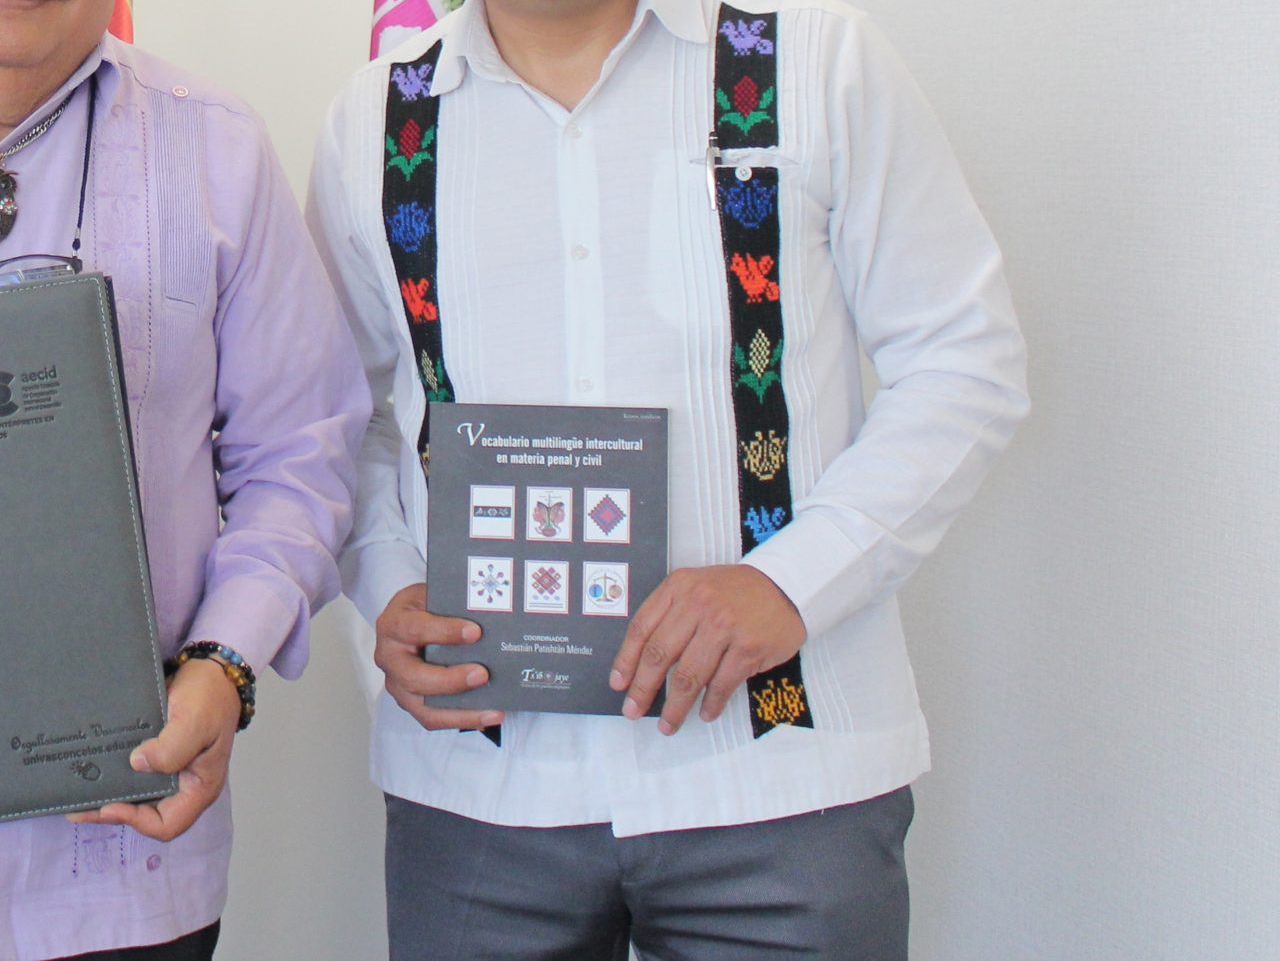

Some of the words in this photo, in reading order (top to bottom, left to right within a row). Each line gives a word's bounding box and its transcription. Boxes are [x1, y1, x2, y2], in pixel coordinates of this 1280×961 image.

[21, 365, 58, 383] aecid
[44, 415, 55, 424] EN
[456, 422, 530, 448] Vocabulario
[531, 436, 583, 451] multilingüe
[585, 437, 643, 451] intercultural
[496, 453, 508, 464] en
[510, 452, 545, 465] materia
[547, 453, 573, 468] penal
[574, 455, 581, 468] y
[582, 454, 603, 467] civil
[523, 634, 569, 643] COORDINADOR
[500, 641, 533, 652] Sebastián
[566, 644, 593, 655] Méndez
